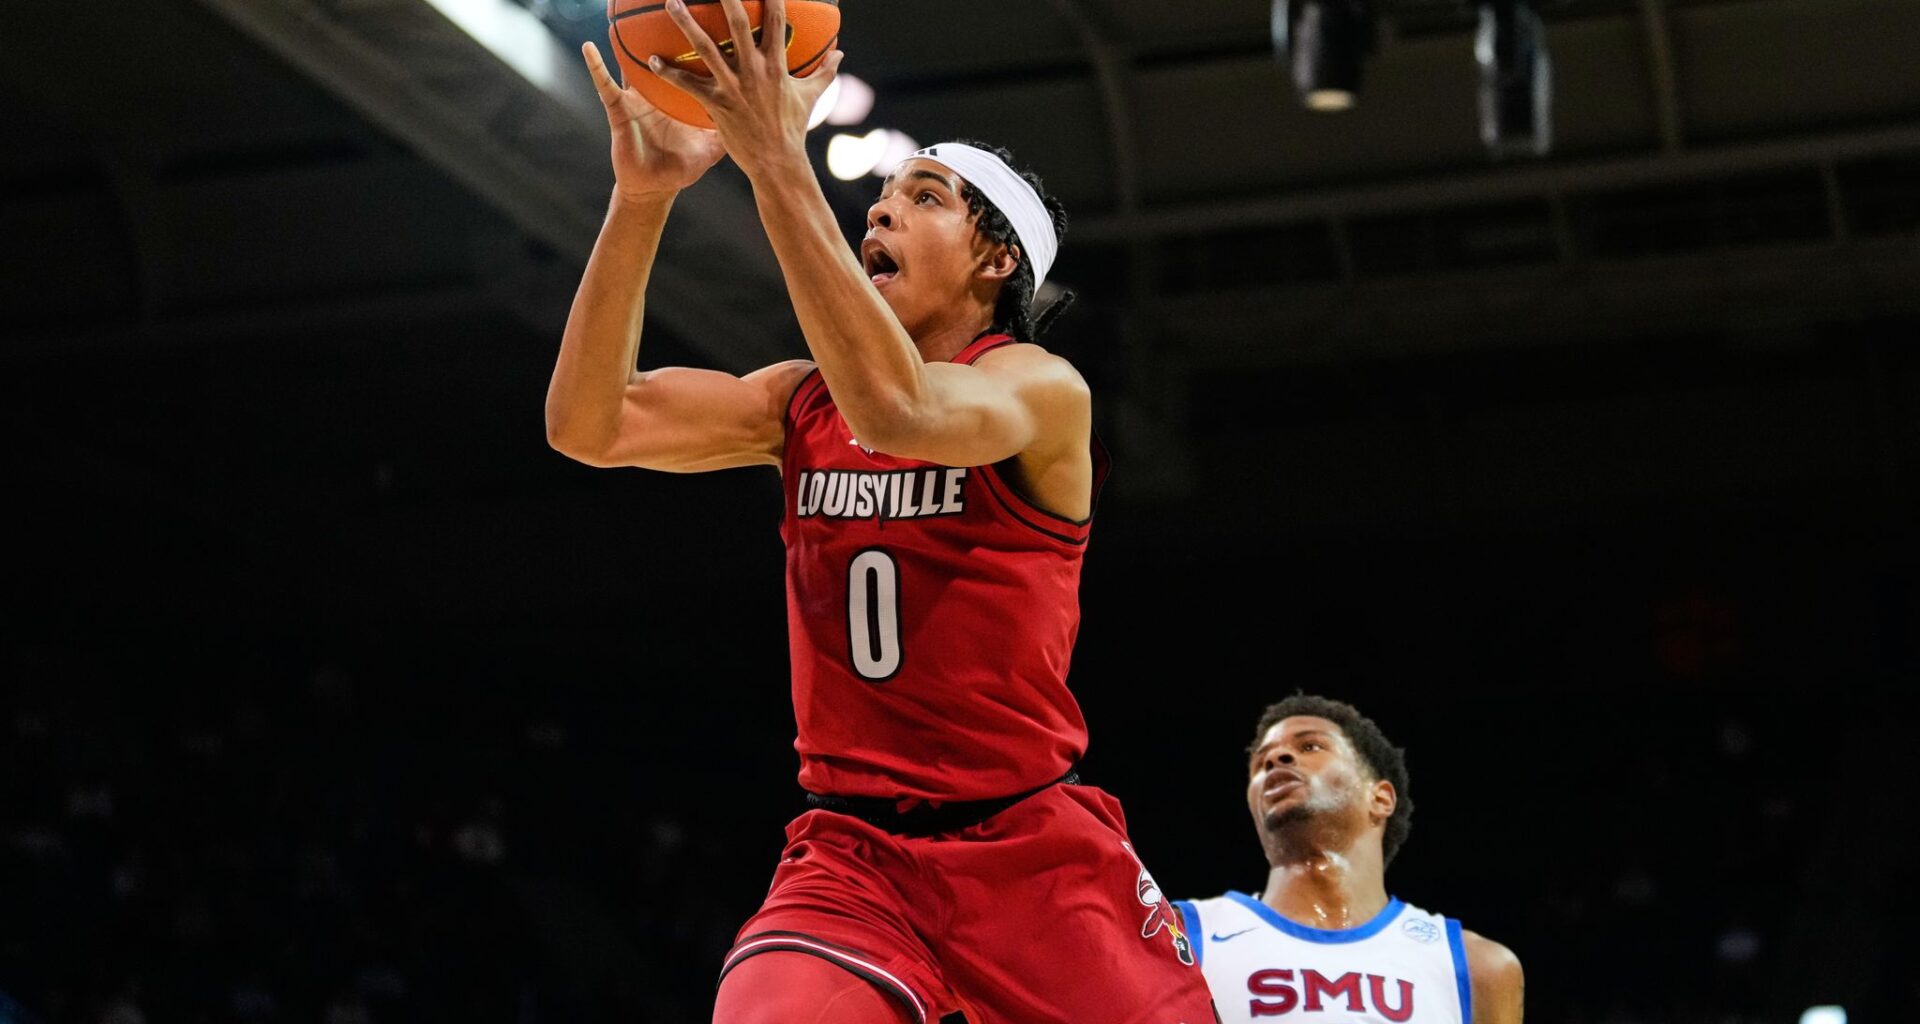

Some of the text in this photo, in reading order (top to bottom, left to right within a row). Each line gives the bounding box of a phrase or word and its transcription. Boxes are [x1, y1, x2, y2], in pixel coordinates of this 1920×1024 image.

[797, 467, 967, 520] LOUISVILLE
[848, 549, 901, 680] 0
[1247, 968, 1414, 1023] SMU
